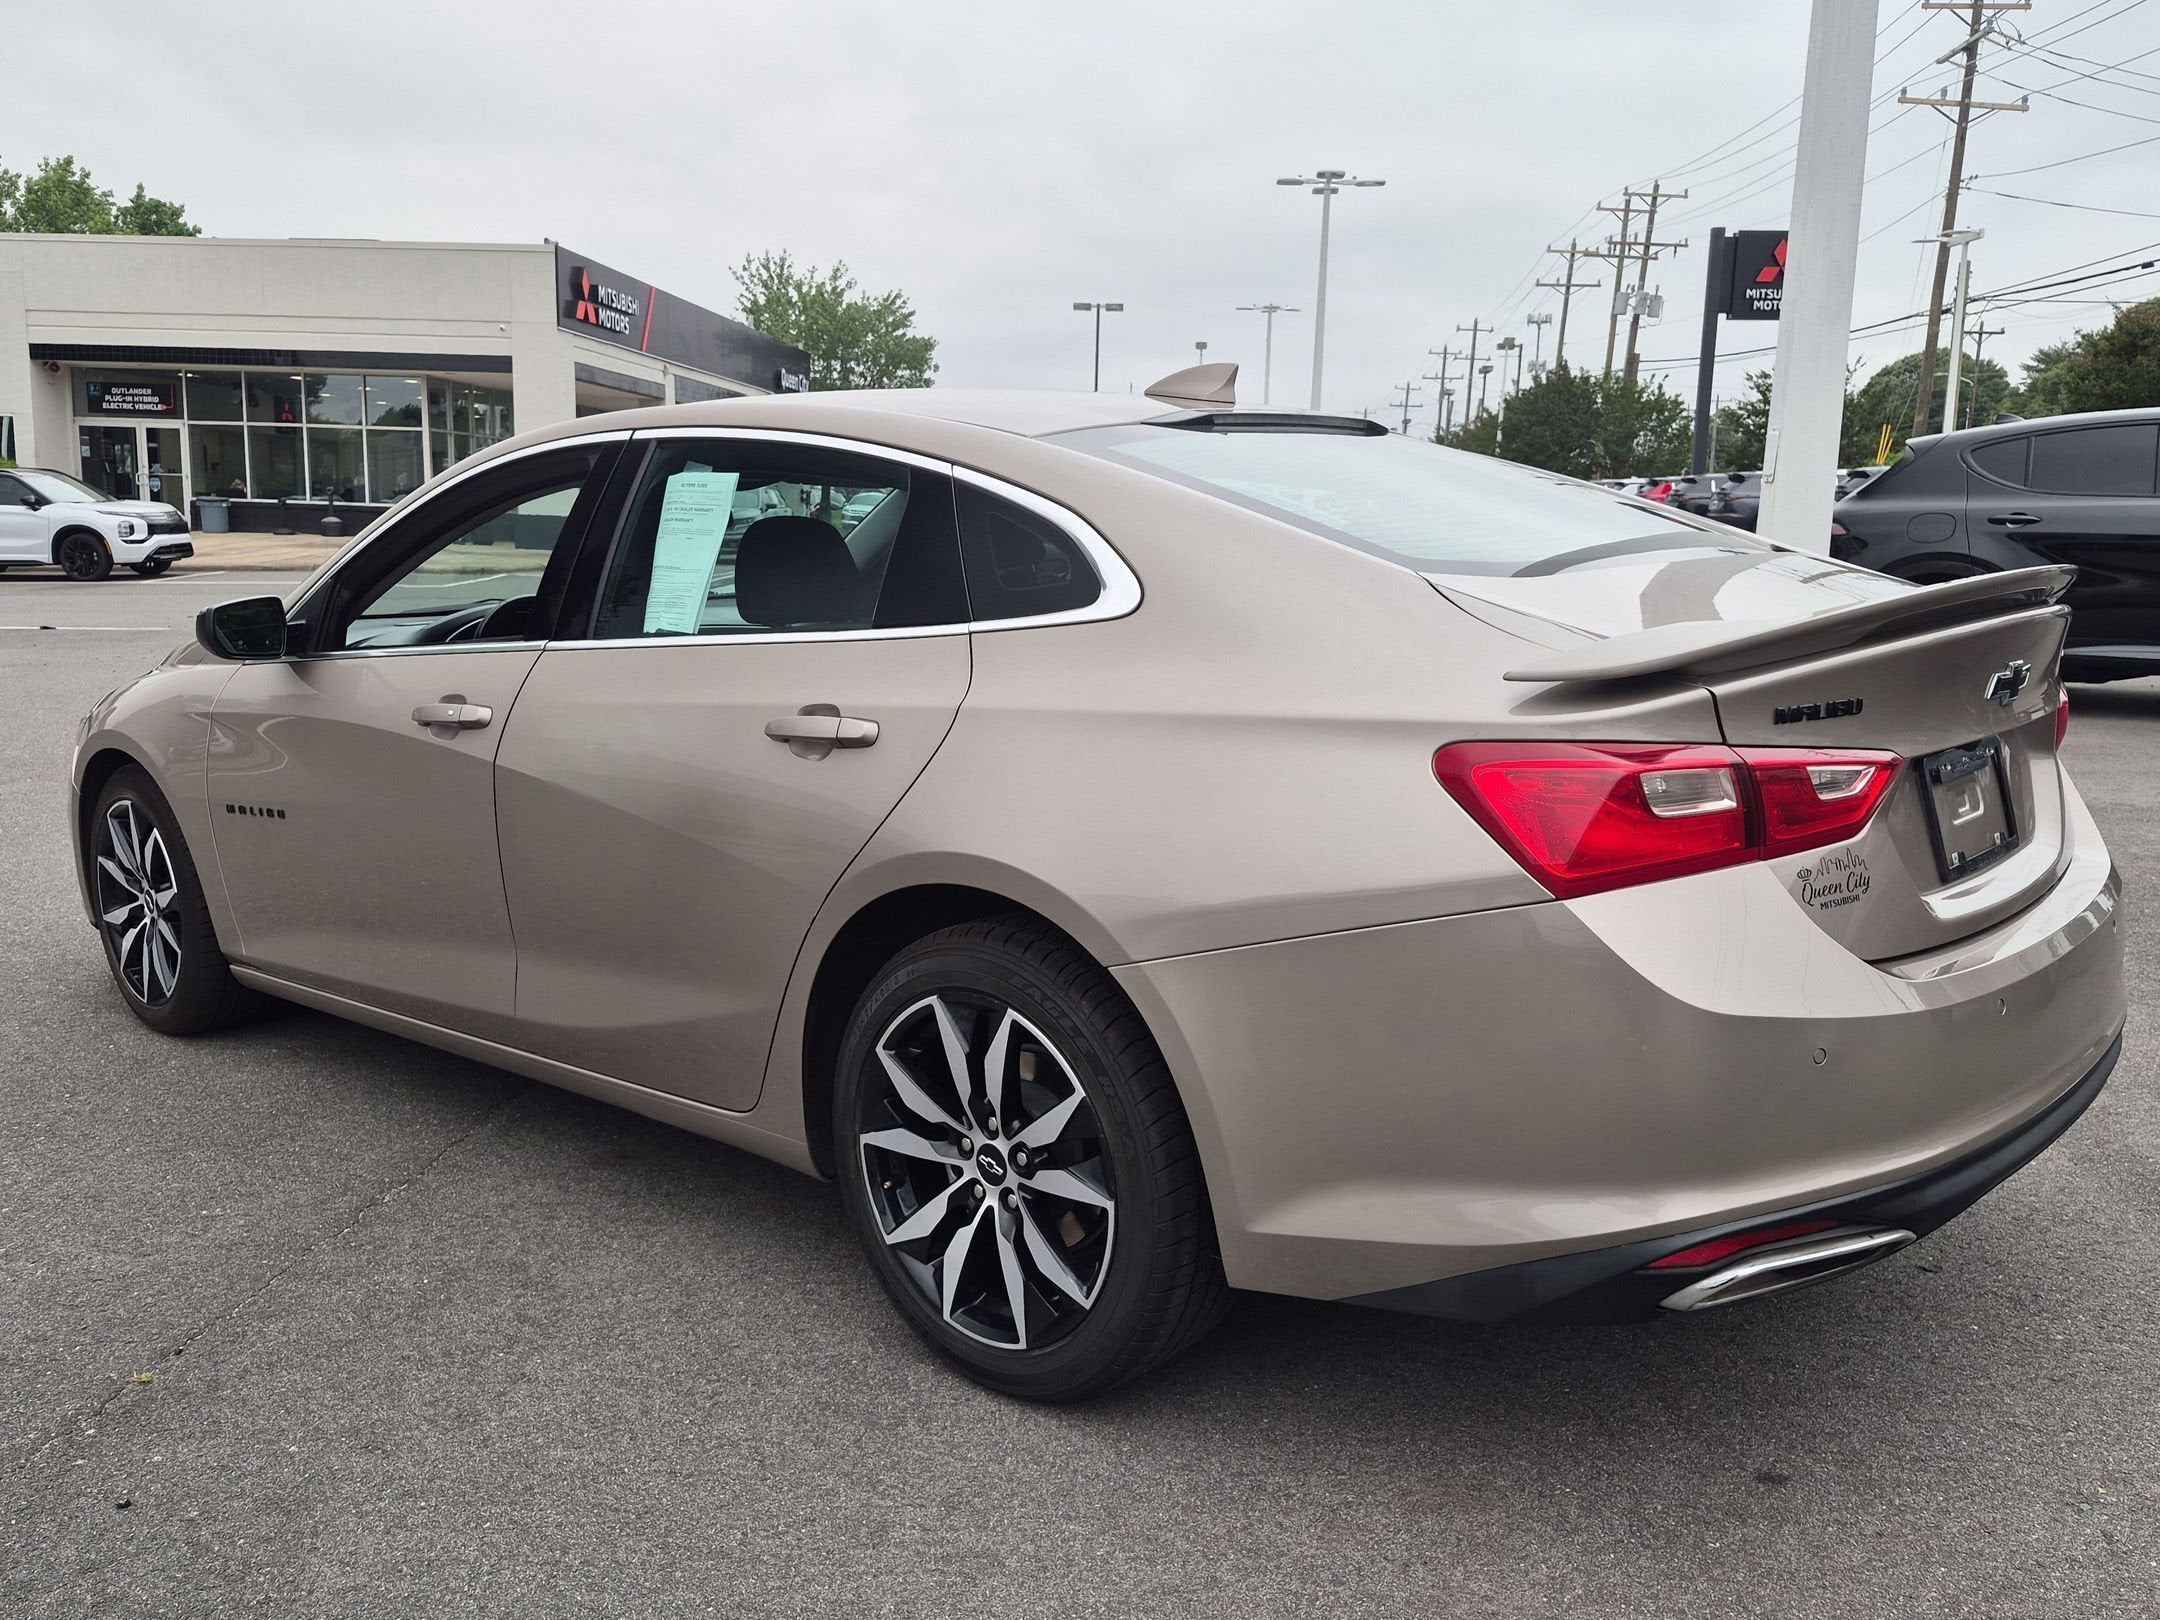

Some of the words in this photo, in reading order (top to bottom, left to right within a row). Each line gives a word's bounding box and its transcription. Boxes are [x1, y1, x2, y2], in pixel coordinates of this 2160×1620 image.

[598, 284, 640, 316] MITSUBISHI
[1745, 288, 1782, 299] MITSU
[1753, 300, 1781, 310] MOT
[598, 307, 630, 335] MOTORS
[104, 394, 133, 402] PLUG-IN
[133, 395, 160, 403] HYBRID
[111, 387, 152, 395] OUTLANDER
[102, 402, 134, 410] ELECTRIC
[134, 403, 162, 411] VEHICLE
[1773, 697, 1863, 725] MALIBU
[226, 804, 286, 820] MALIBU
[1801, 881, 1843, 907] Queen
[1846, 871, 1871, 895] City
[1820, 893, 1860, 911] MITSUBISHI
